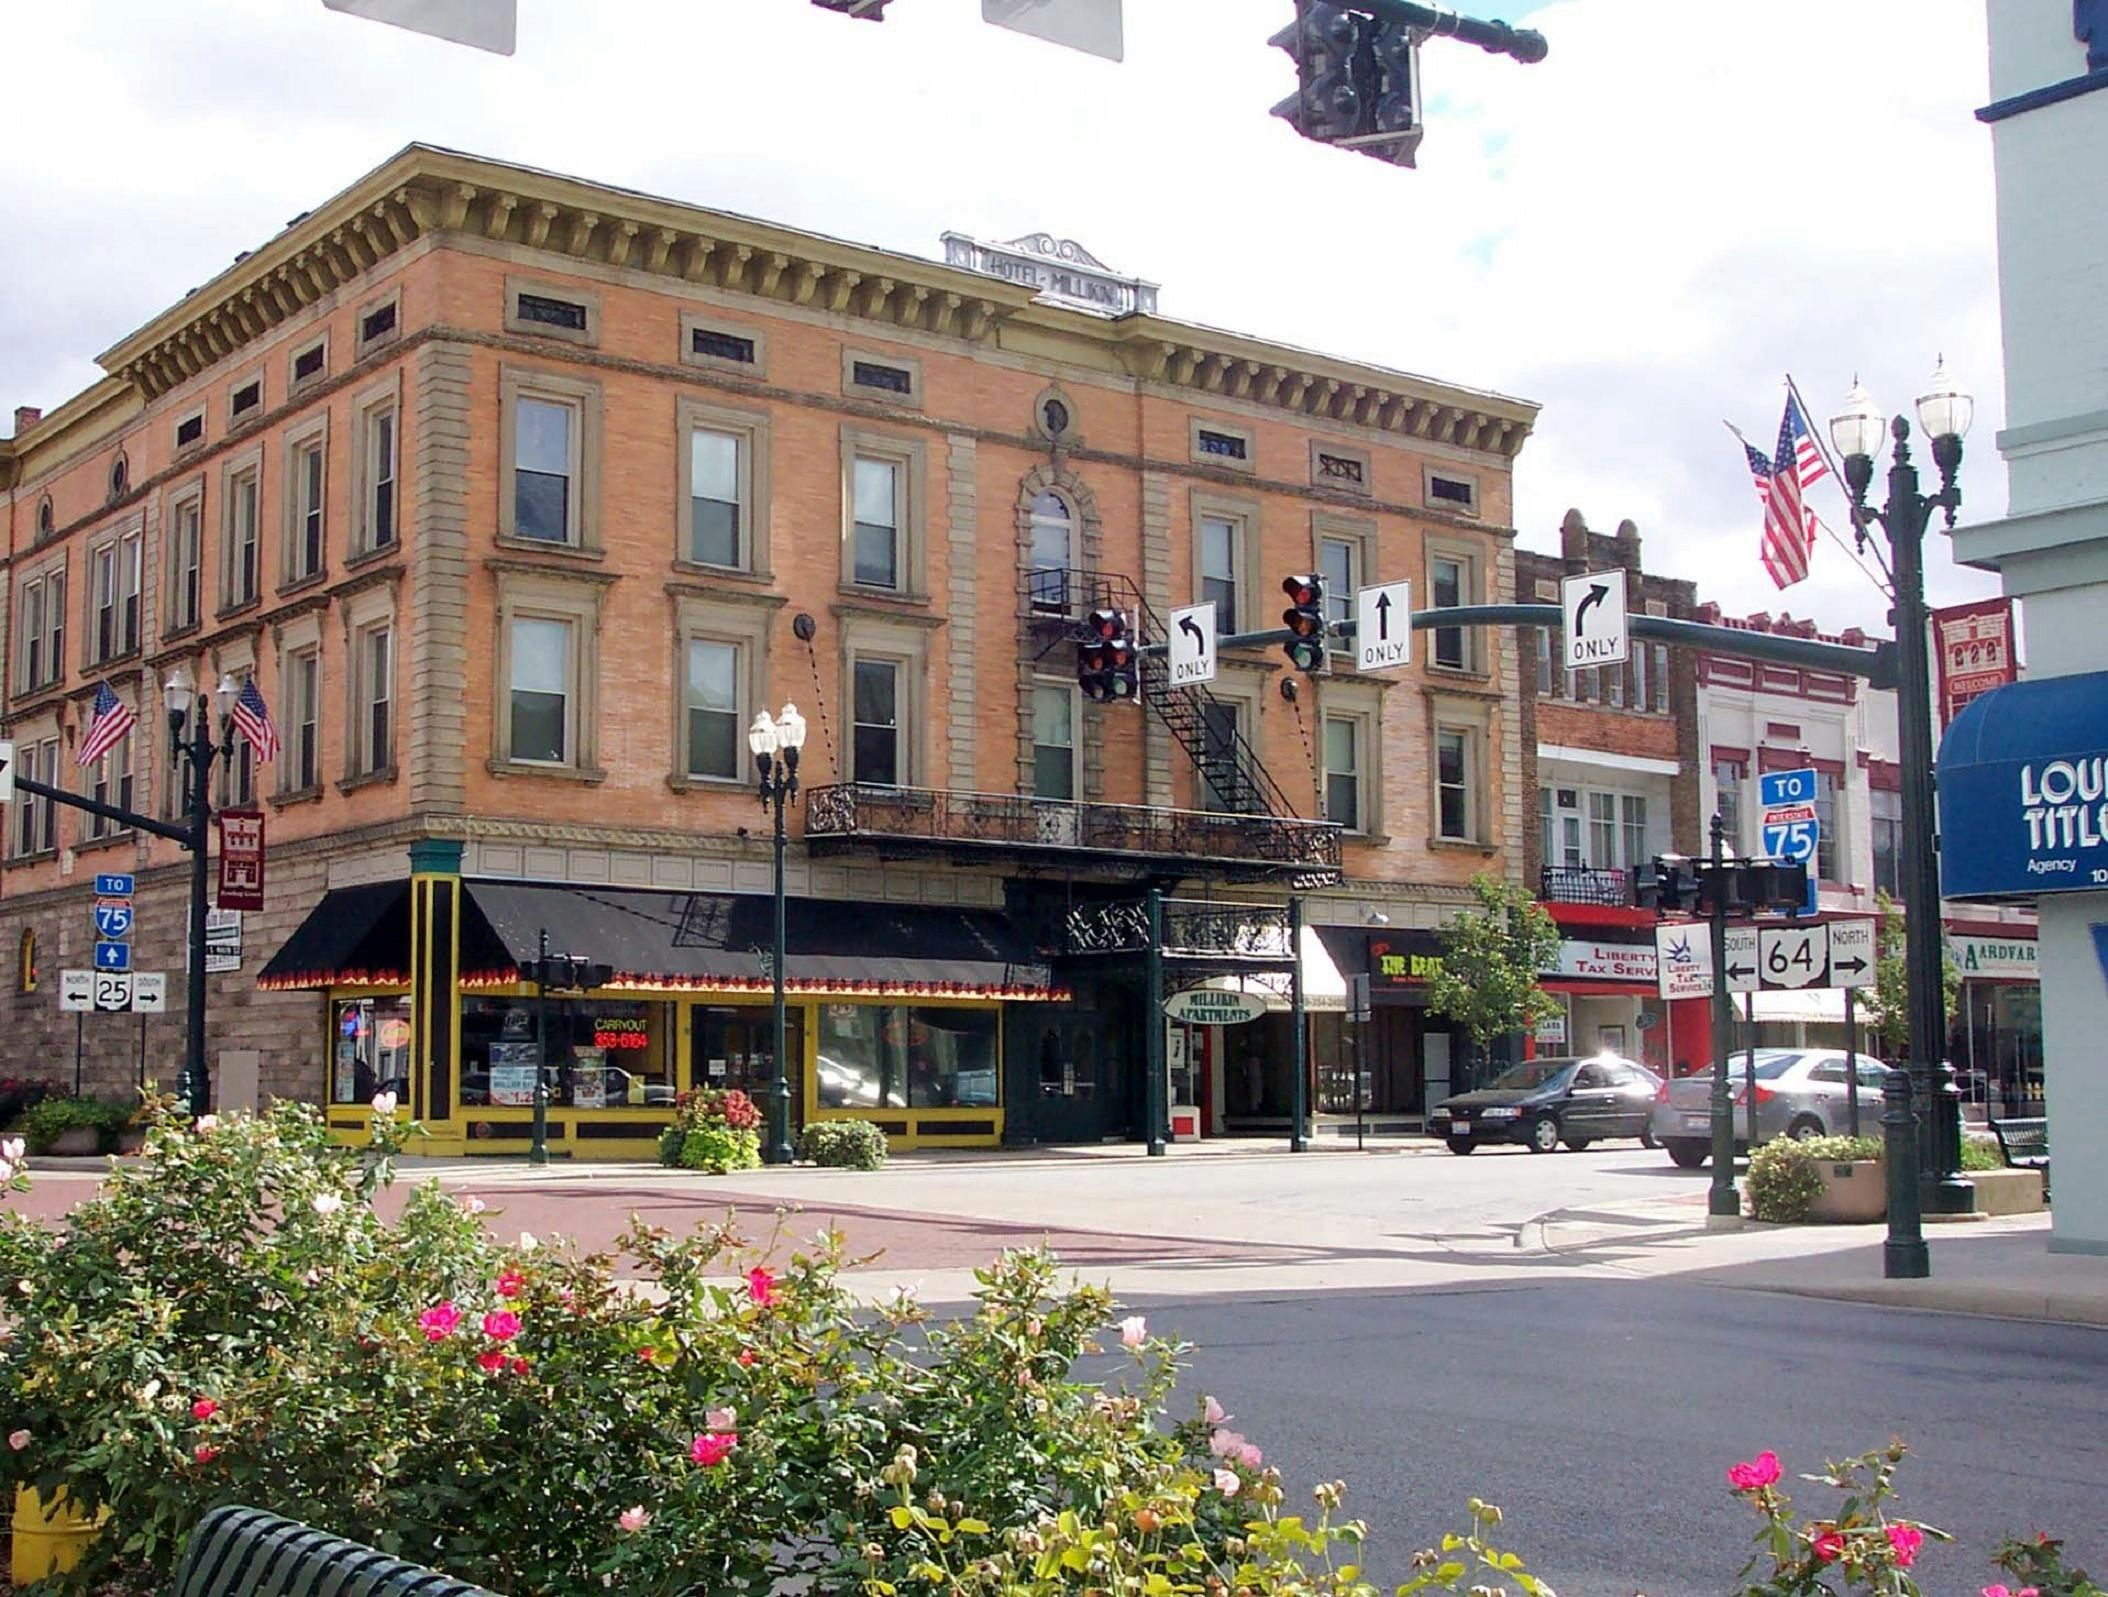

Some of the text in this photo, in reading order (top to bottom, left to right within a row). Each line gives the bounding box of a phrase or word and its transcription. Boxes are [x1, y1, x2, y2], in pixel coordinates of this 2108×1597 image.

[1365, 643, 1404, 663] ONLY
[1576, 637, 1619, 659] ONLY
[1177, 660, 1208, 679] ONLY
[1952, 676, 2000, 692] WELCOME
[1774, 778, 1802, 797] TO
[1767, 823, 1812, 859] 75
[2027, 859, 2077, 874] Agency
[105, 878, 124, 891] TO
[98, 908, 128, 930] 75
[1723, 936, 1756, 951] SOUTH
[1832, 930, 1869, 945] NORTH
[1594, 947, 1657, 962] LIBERTY
[1768, 938, 1812, 973] 64
[1380, 955, 1405, 975] THE
[1576, 960, 1606, 974] TAX
[1667, 963, 1700, 973] LIBERTY
[98, 980, 127, 1002] 25
[1179, 1008, 1251, 1022] APARTMENTS
[594, 1017, 648, 1032] CARRYOUT
[594, 1032, 648, 1049] 353-6164
